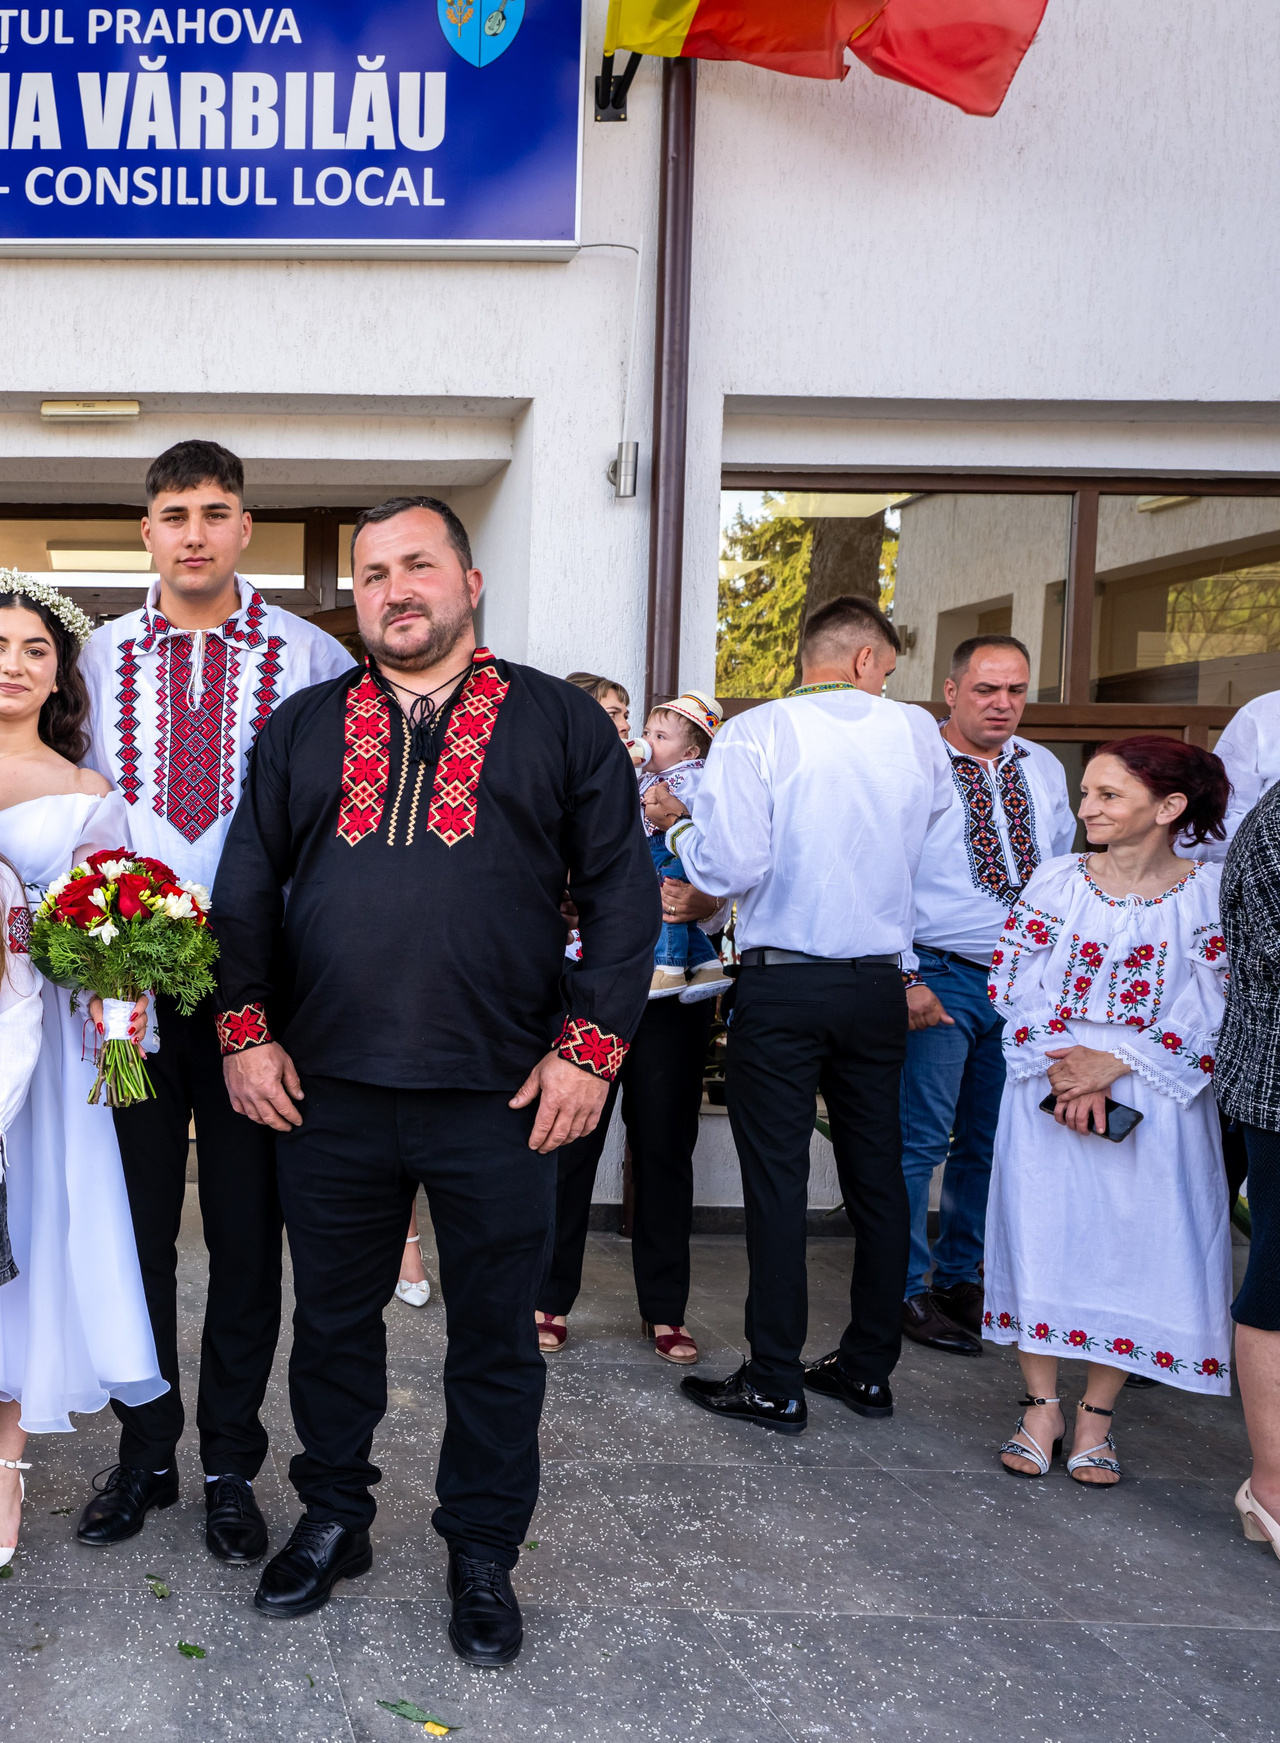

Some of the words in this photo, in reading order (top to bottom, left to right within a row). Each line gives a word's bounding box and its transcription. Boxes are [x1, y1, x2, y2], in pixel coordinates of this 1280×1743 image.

[88, 7, 303, 46] PRAHOVA
[77, 54, 448, 152] VĂRBILĂU
[25, 166, 278, 207] CONSILIUL
[293, 166, 446, 207] LOCAL
